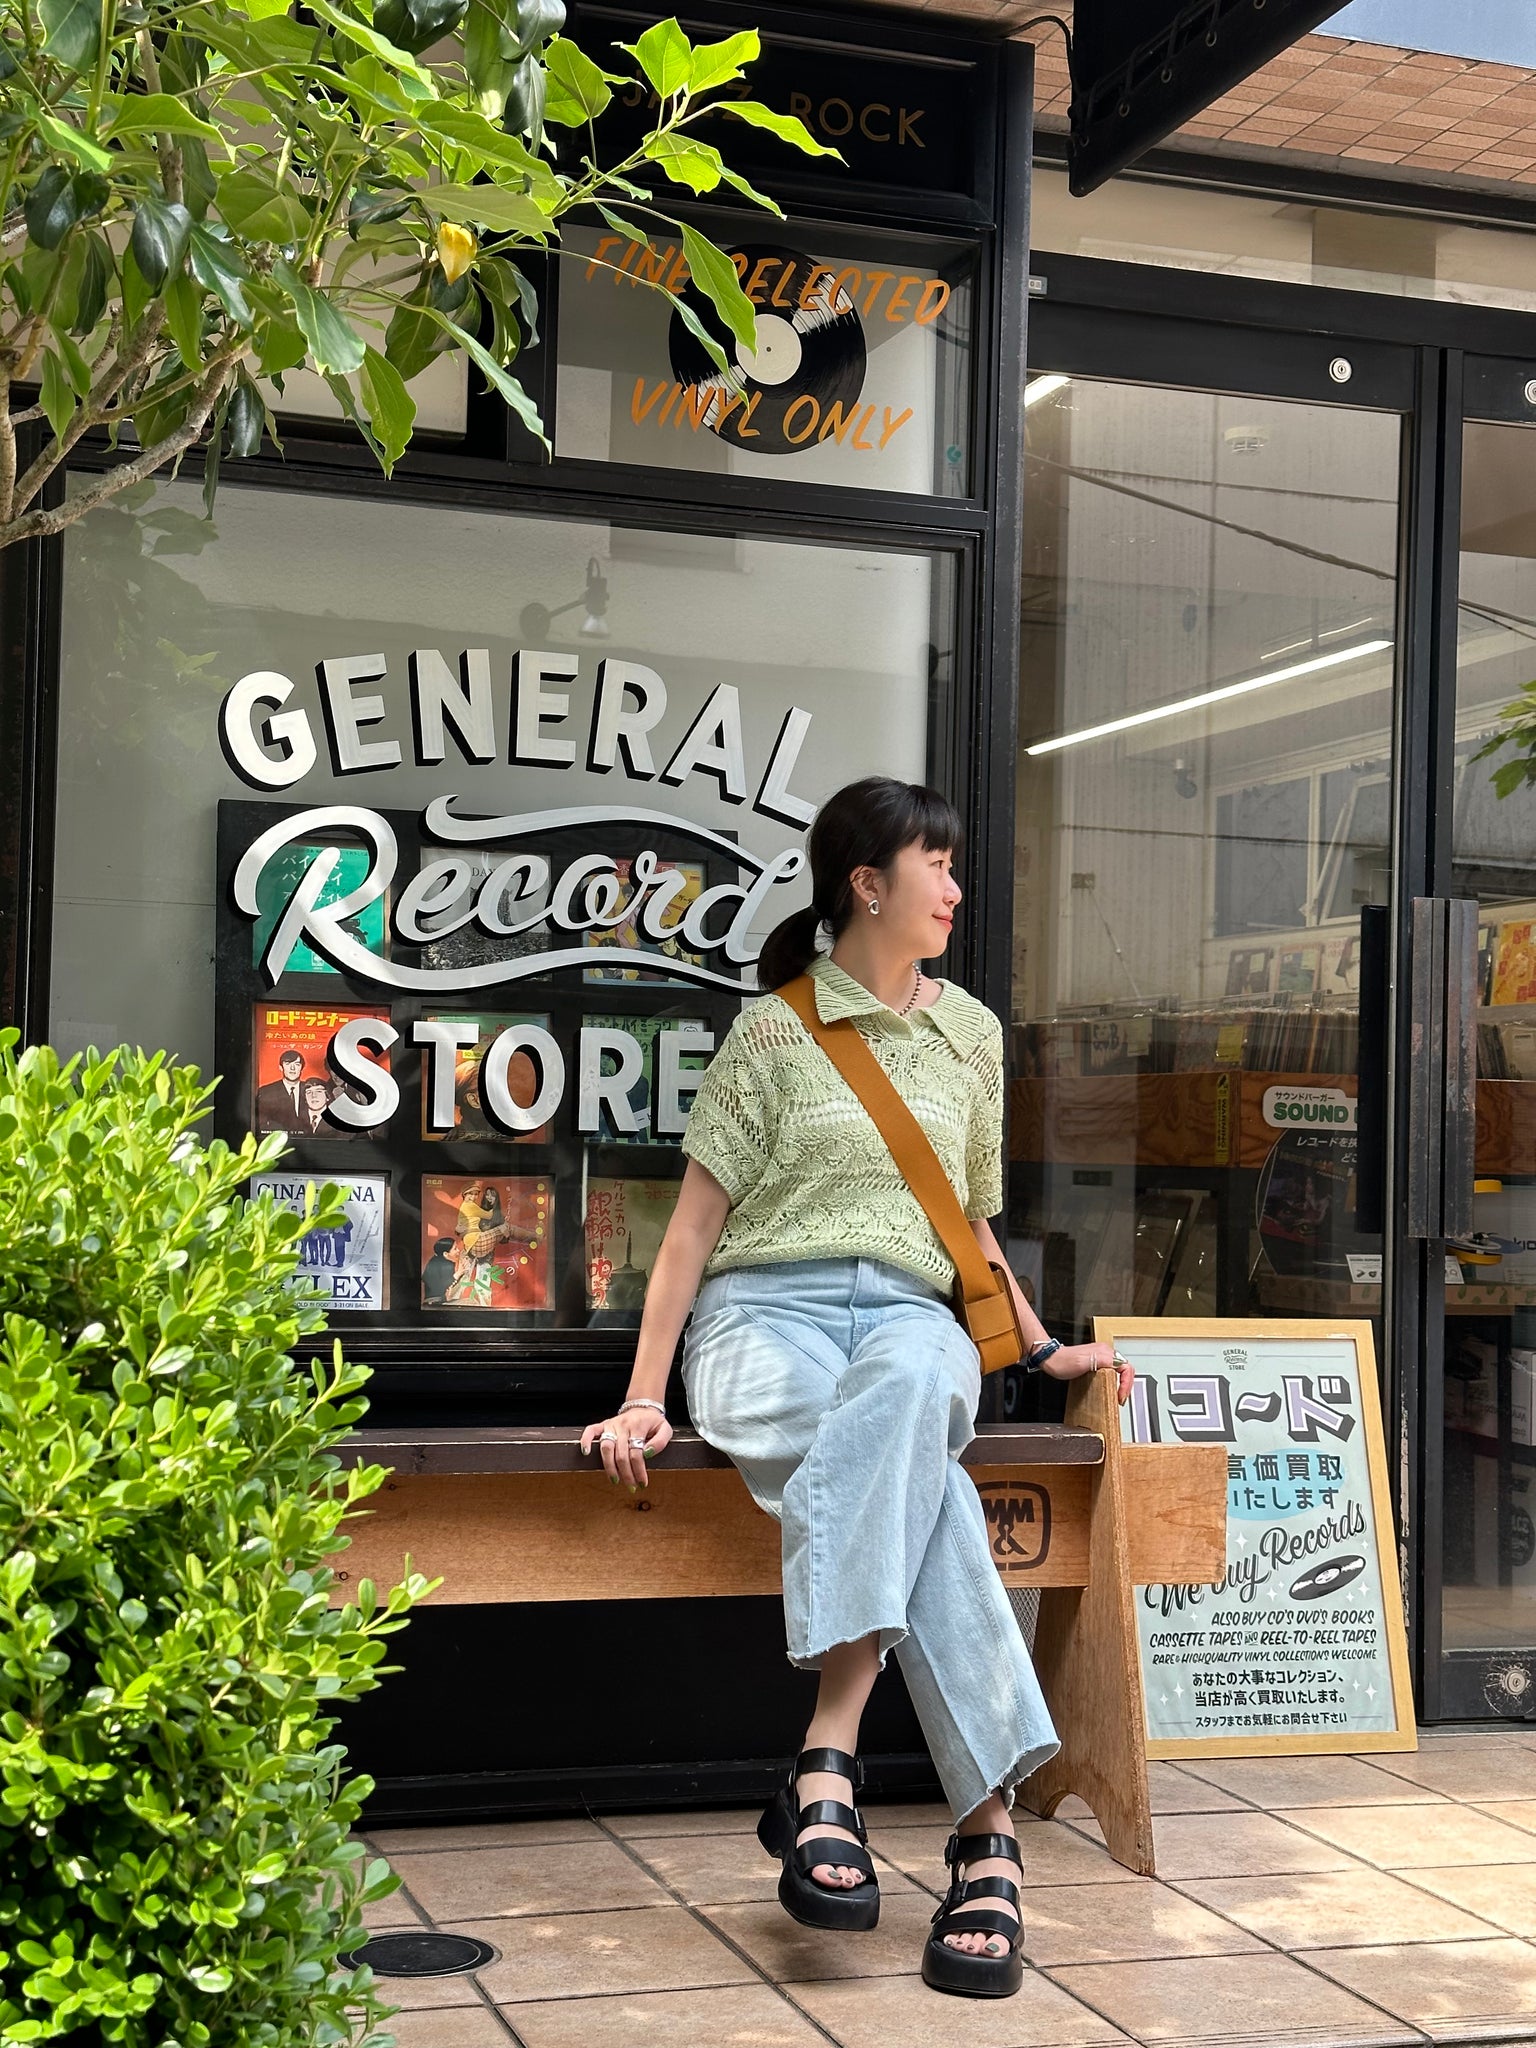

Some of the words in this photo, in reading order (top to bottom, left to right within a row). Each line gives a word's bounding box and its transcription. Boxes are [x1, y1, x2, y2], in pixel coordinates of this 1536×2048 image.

[790, 91, 926, 148] ROCK
[585, 236, 698, 294] FINE
[630, 378, 760, 438] VINYL
[783, 393, 914, 451] ONLY
[219, 648, 819, 831] GENERAL
[319, 1017, 714, 1138] STORE
[1275, 1091, 1335, 1102] サウンドバーガー
[1273, 1102, 1349, 1123] SOUND
[1227, 1453, 1343, 1481] 高価買取
[1259, 1500, 1367, 1571] Records
[1211, 1611, 1241, 1627] ALSO
[1242, 1611, 1266, 1625] BUY
[1331, 1609, 1375, 1625] BOOKS
[1149, 1632, 1206, 1648] CASSETTE
[1208, 1630, 1243, 1646] TAPES
[1260, 1629, 1341, 1645] REEL-TO-REEL
[1342, 1629, 1377, 1644] TAPES
[1244, 1651, 1272, 1662] VINYL
[1273, 1650, 1330, 1662] COLLECTIONS
[1331, 1649, 1377, 1660] WELCOME
[1192, 1669, 1345, 1687] あなたの大事なコレクション、
[1195, 1689, 1346, 1707] 当店が高く買取いたします。
[1195, 1712, 1348, 1728] スタッフまでお気軽にお問合せ下さい
